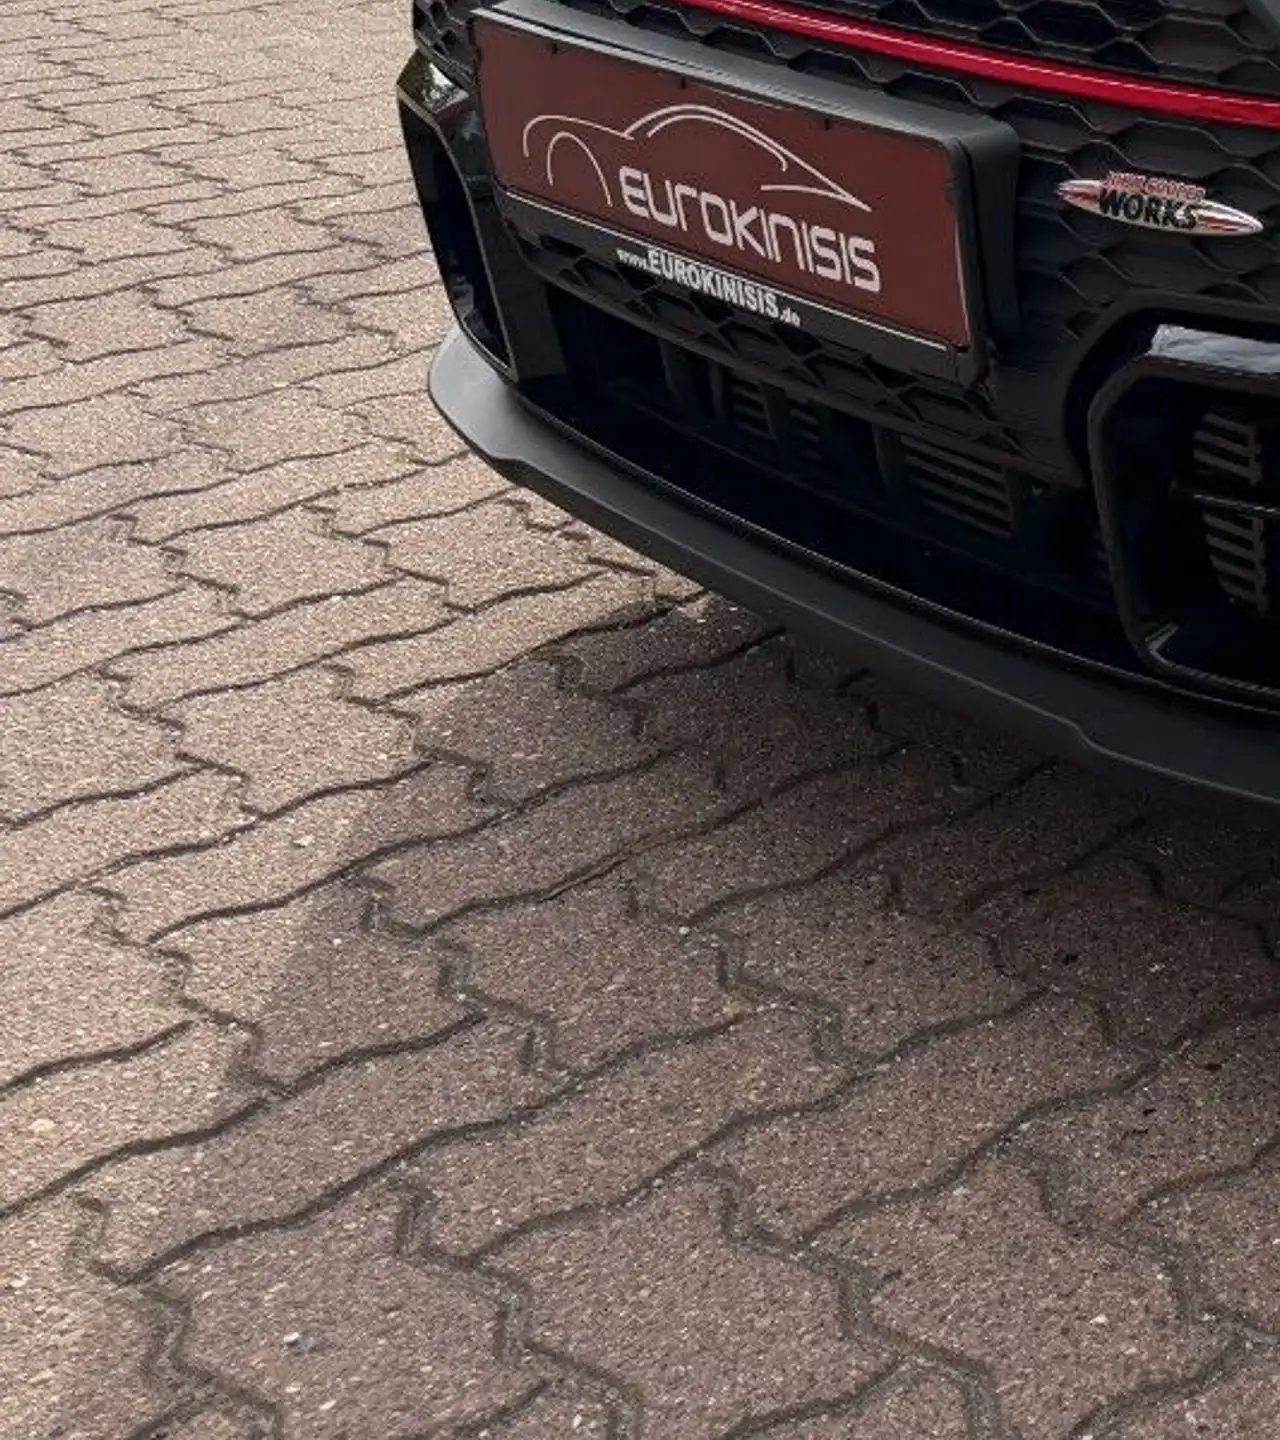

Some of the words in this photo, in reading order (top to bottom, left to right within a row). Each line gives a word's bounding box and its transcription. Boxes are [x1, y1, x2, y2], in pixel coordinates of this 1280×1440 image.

[619, 165, 881, 293] EUROKINISIS
[1101, 189, 1198, 231] WORKS
[616, 247, 801, 329] www.EUROKINISIS.de
